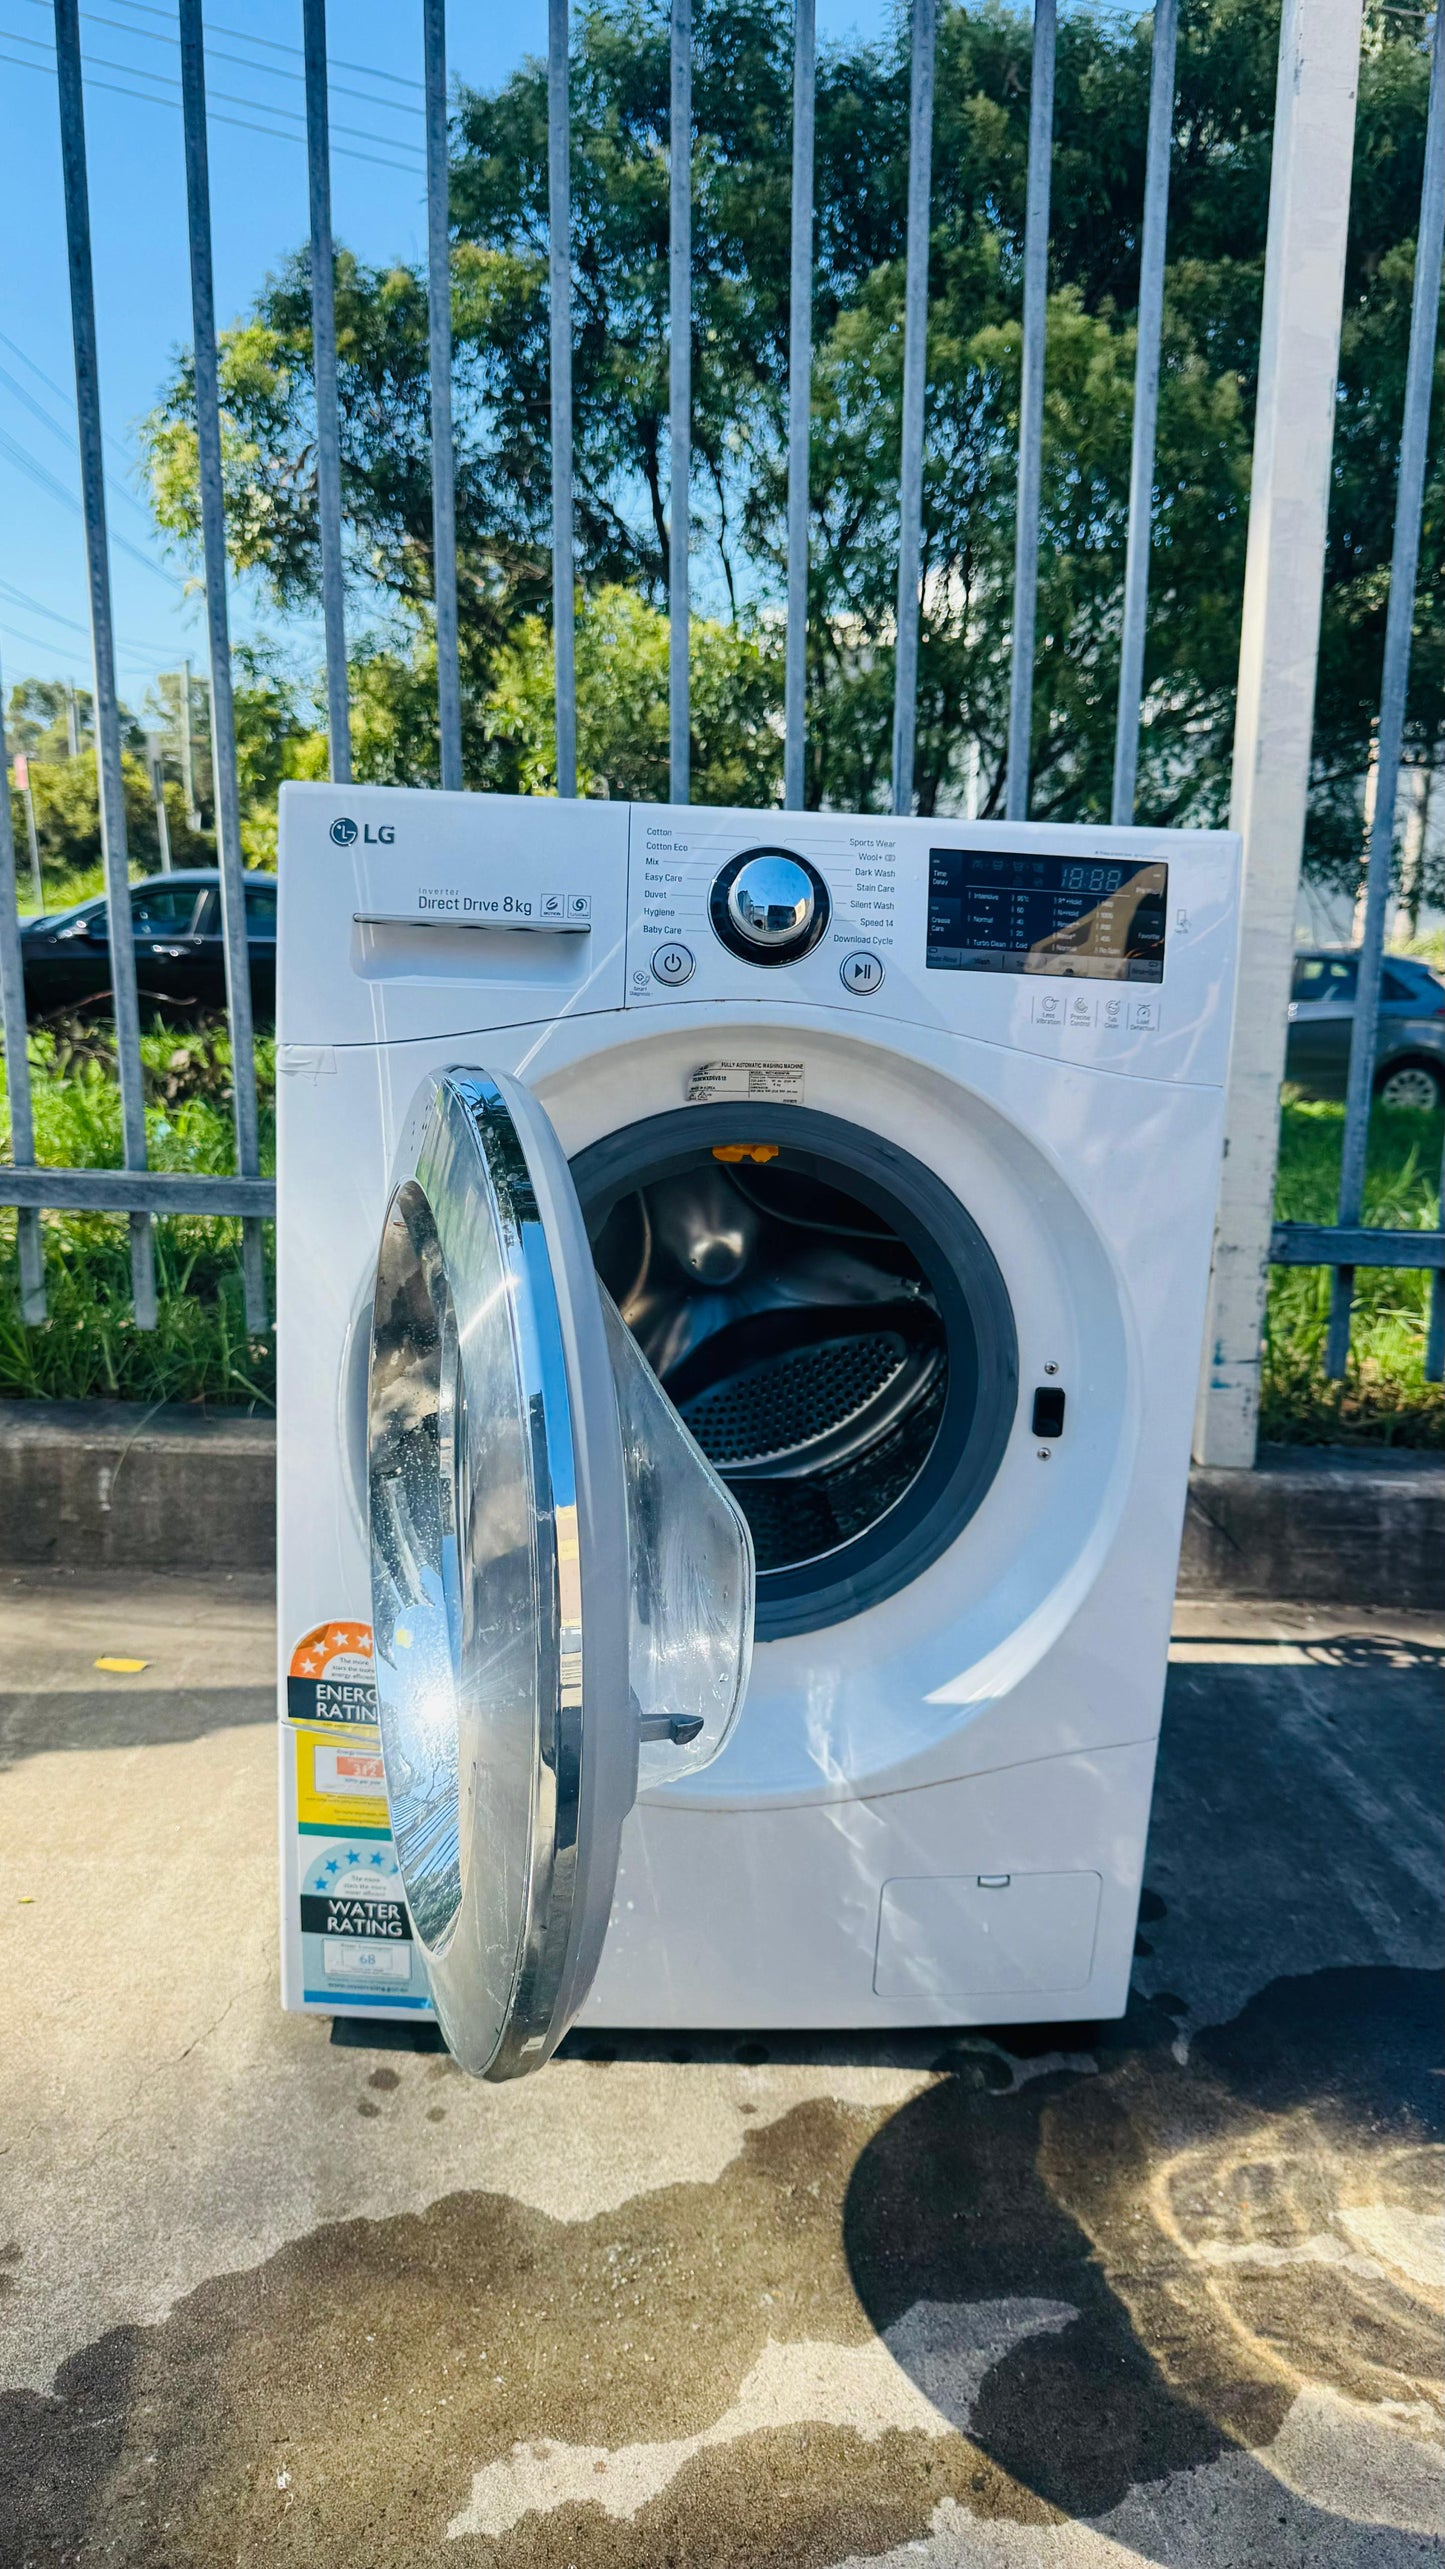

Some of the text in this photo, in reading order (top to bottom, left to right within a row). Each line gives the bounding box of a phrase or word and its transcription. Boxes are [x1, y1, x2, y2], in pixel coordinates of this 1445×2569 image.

[364, 823, 395, 844] LG
[646, 827, 673, 836] Cotton
[646, 842, 688, 852] Cotton Eco
[849, 838, 896, 848] Sports Wear
[645, 857, 660, 865] Mix
[858, 853, 883, 861] Wool+
[645, 873, 683, 882] Easy Care
[855, 868, 896, 877] Dark Wash
[933, 869, 948, 877] Time
[932, 878, 949, 886] Delay
[418, 887, 460, 896] Inverter
[856, 883, 895, 893] Stain Care
[644, 890, 667, 899] Duvet
[418, 896, 460, 911] Direct
[463, 897, 499, 912] Drive
[850, 900, 895, 910] Silent Wash
[643, 907, 675, 917] Hygiene
[860, 918, 894, 927] Speed 14
[643, 925, 682, 935] Baby Care
[833, 934, 894, 946] Download Cycle
[1070, 1013, 1091, 1021] Precise
[316, 1684, 377, 1704] ENERG
[316, 1701, 377, 1721] RATIN
[328, 1900, 401, 1920] WATER
[327, 1916, 403, 1937] RATING
